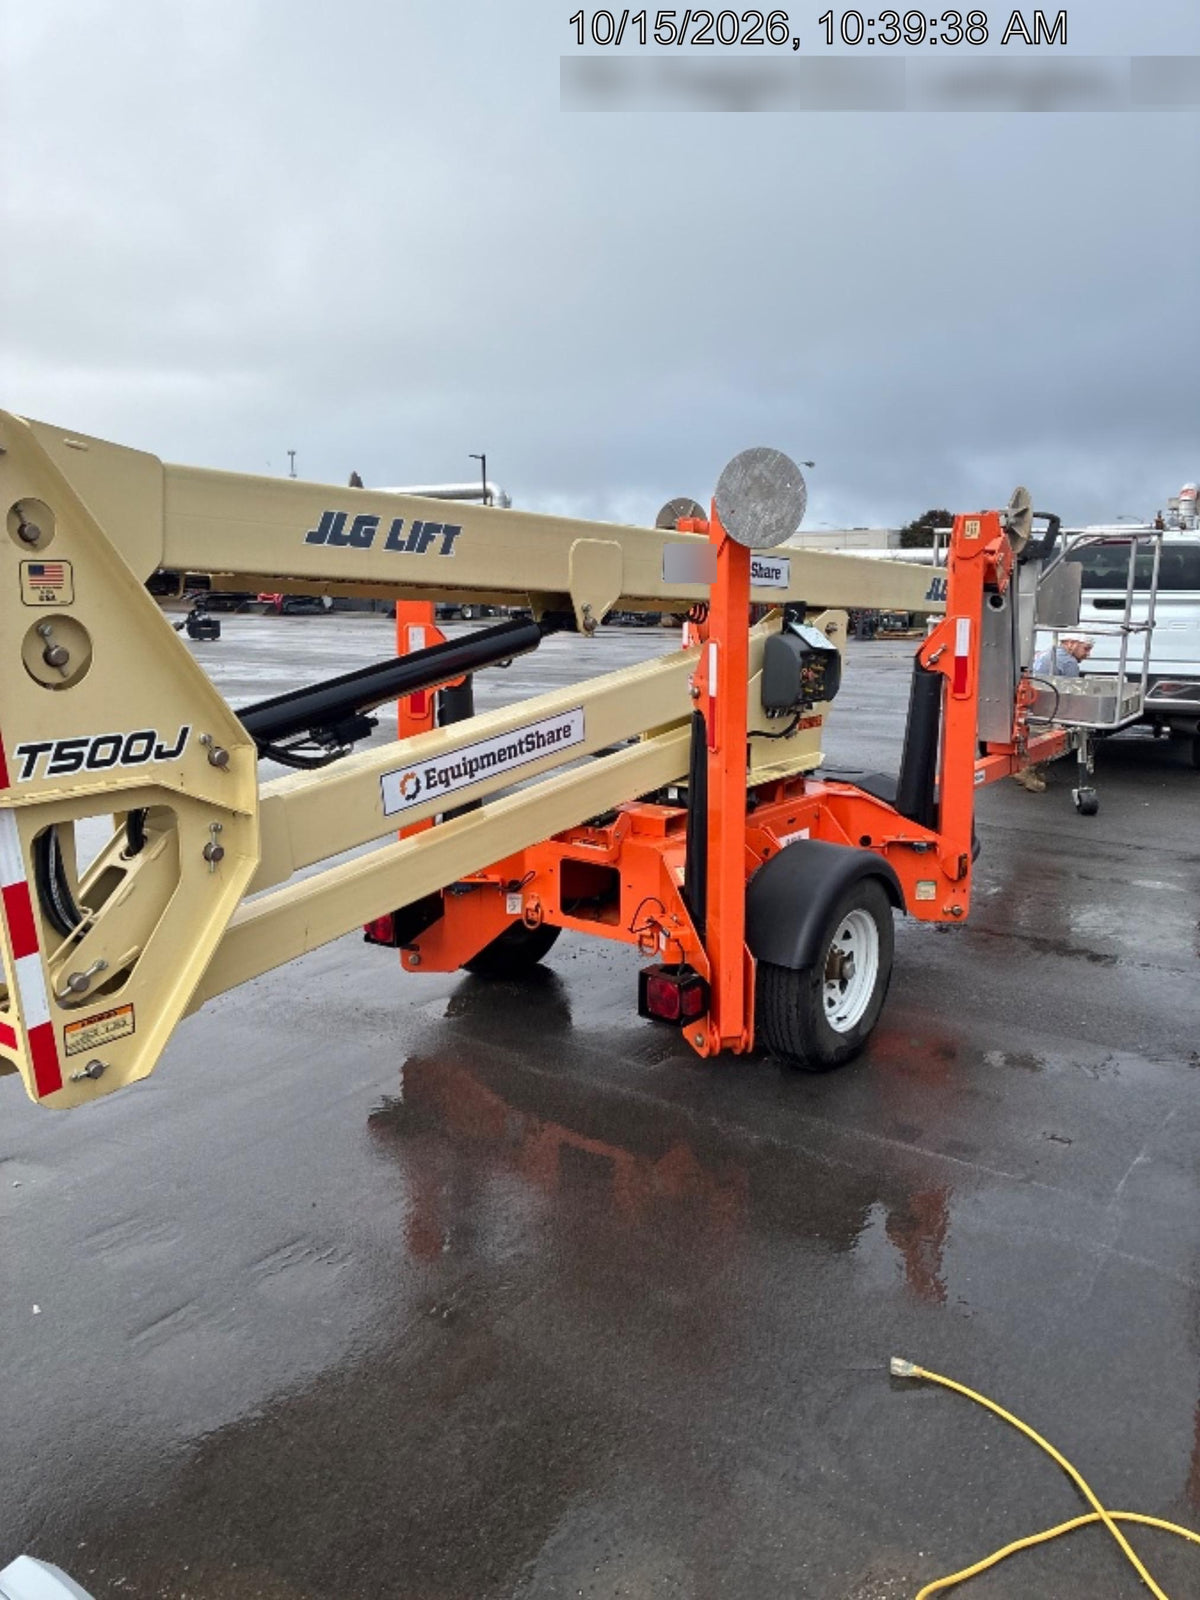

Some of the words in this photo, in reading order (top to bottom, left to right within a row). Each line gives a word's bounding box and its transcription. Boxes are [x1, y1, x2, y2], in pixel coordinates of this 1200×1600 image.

[303, 510, 381, 549] JLG
[383, 517, 462, 556] LIFT
[15, 725, 192, 781] T500J
[424, 724, 572, 790] EquipmentShare
